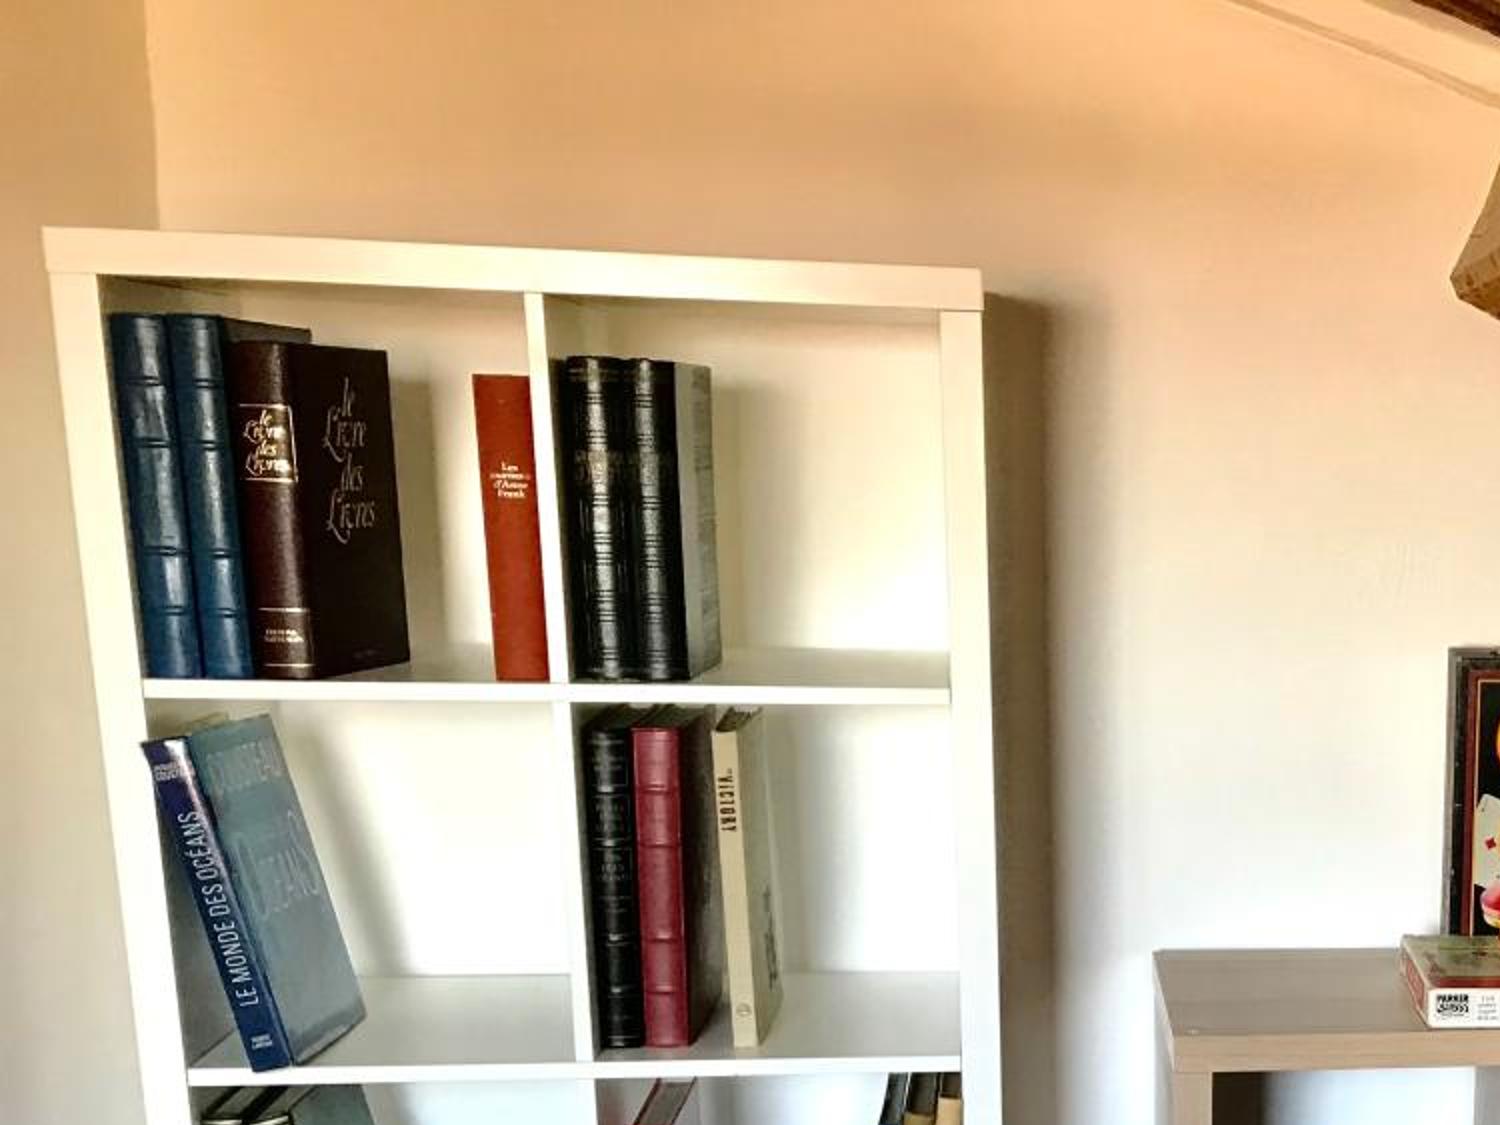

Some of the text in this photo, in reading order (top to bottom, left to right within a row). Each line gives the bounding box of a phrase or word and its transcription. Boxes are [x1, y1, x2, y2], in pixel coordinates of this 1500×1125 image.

[177, 810, 260, 1007] LE MONDE DES OCÉANS
